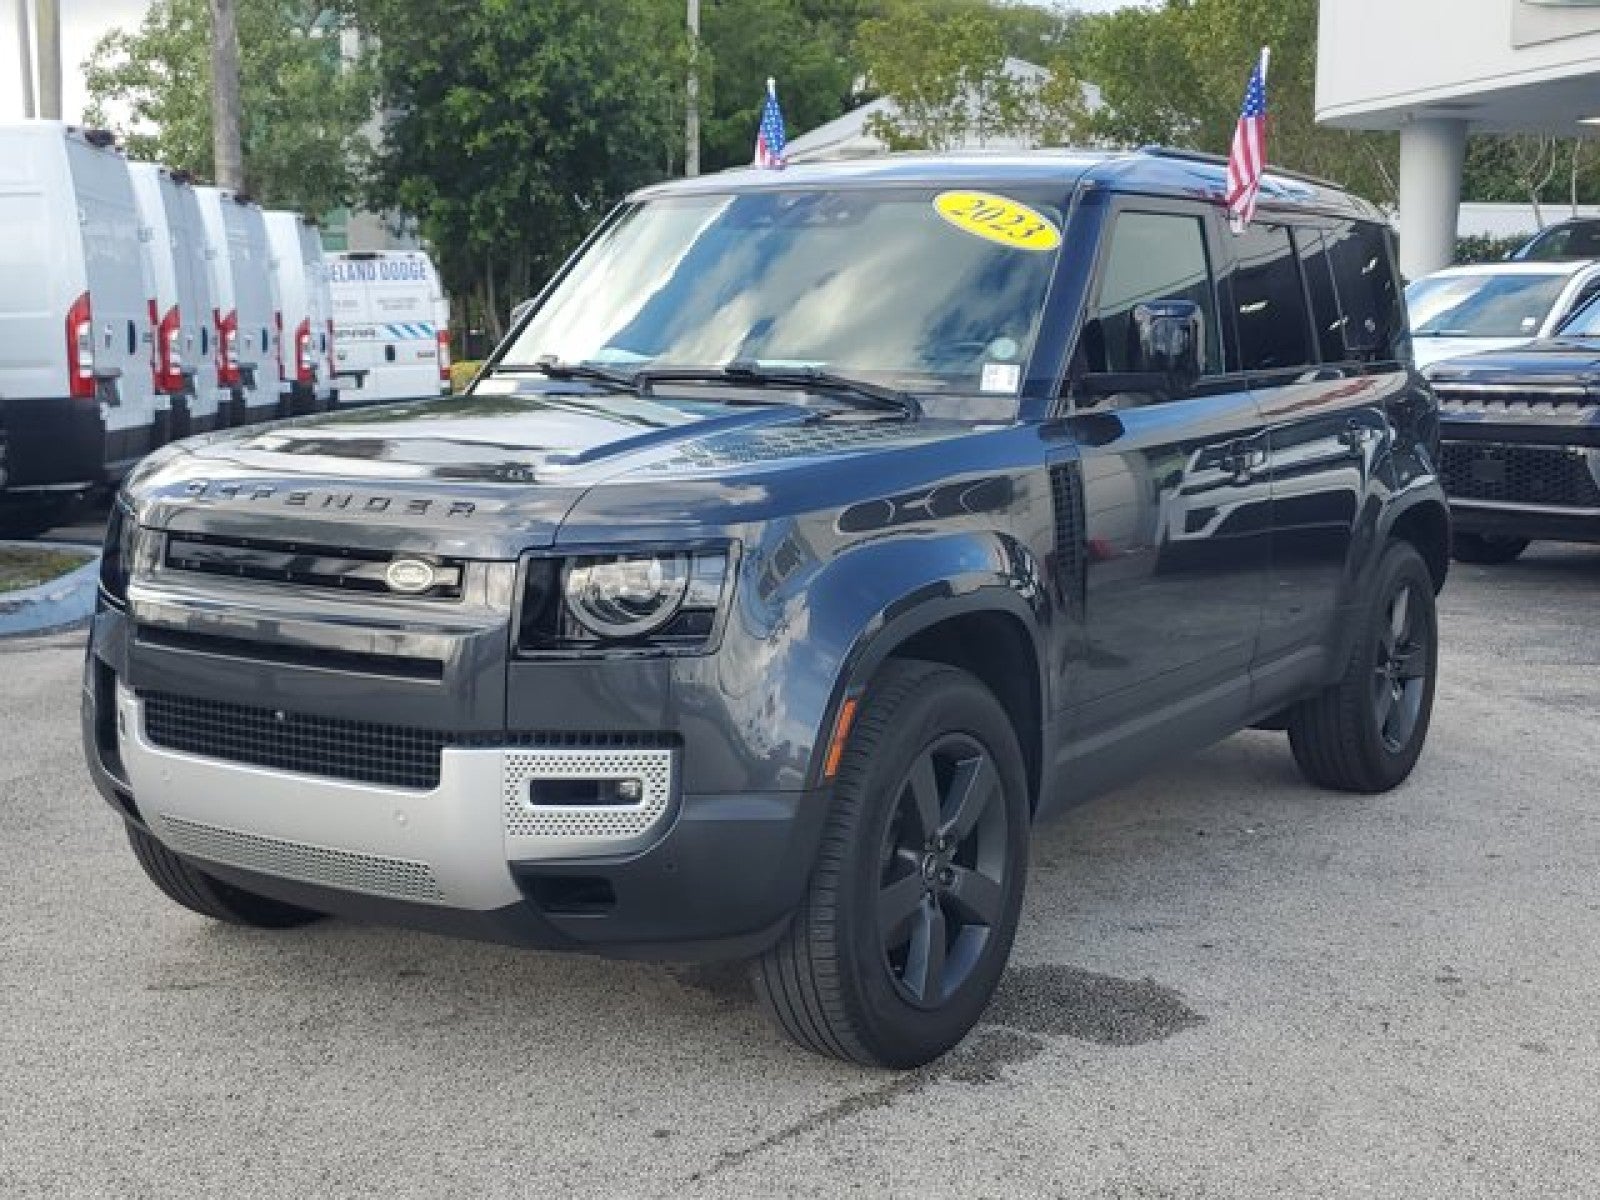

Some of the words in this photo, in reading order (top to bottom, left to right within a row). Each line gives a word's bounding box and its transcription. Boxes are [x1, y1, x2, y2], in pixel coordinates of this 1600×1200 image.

[947, 198, 1047, 239] 2023
[379, 261, 426, 280] DODGE
[185, 480, 477, 518] DEFENDER
